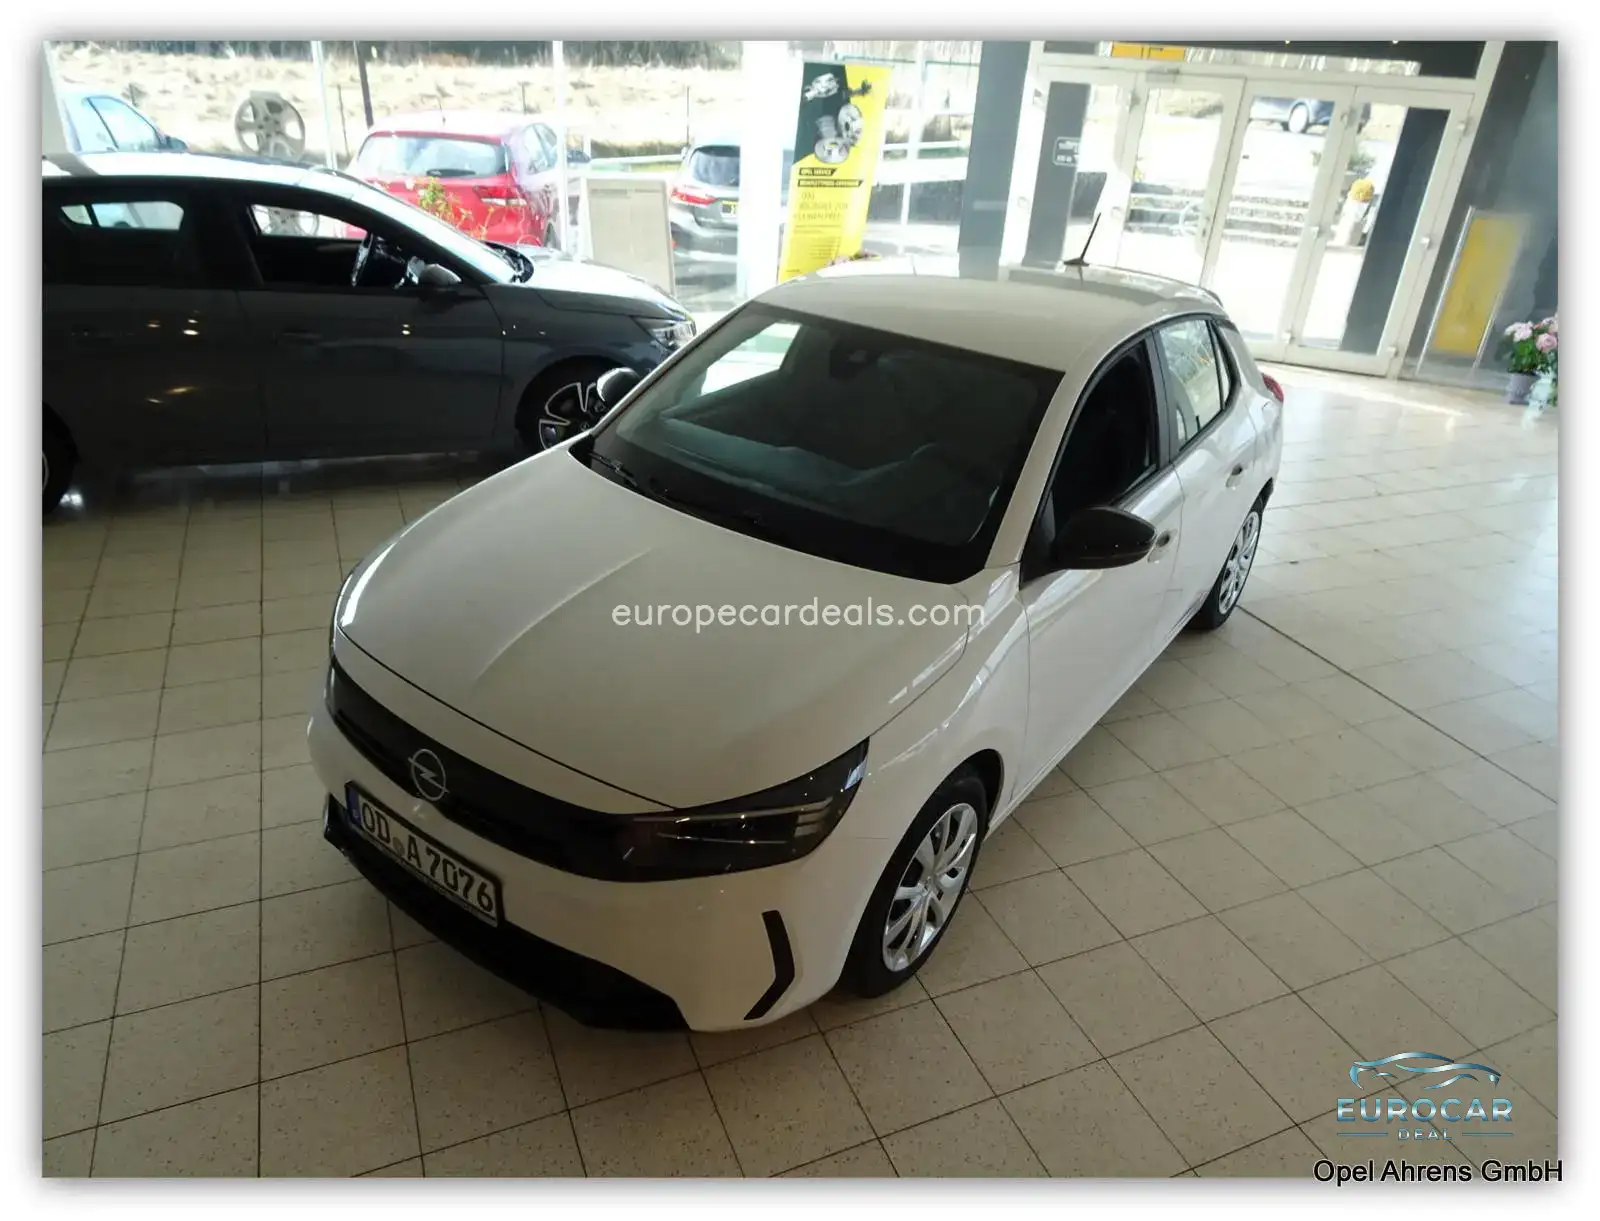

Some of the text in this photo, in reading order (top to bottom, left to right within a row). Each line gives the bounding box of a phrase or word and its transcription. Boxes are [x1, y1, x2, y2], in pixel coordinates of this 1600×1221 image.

[361, 803, 391, 843] OD
[407, 834, 422, 868] A
[425, 845, 494, 912] 7076
